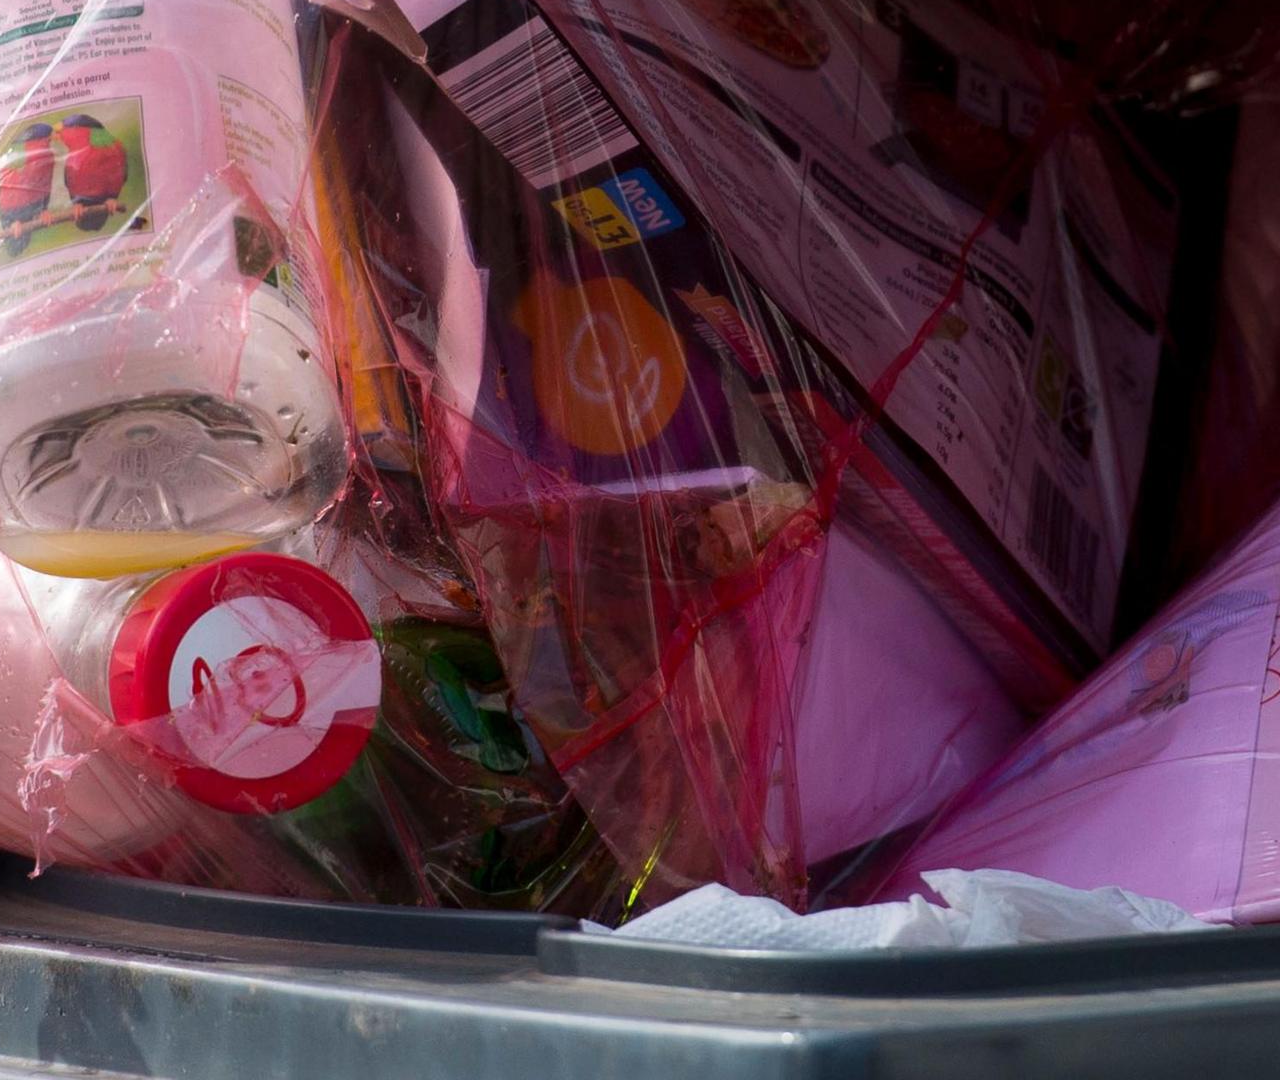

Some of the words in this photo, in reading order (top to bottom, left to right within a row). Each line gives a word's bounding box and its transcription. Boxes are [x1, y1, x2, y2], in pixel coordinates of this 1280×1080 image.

[4, 93, 26, 106] othe
[50, 77, 76, 92] here's
[84, 72, 111, 88] parrot
[619, 178, 671, 231] New
